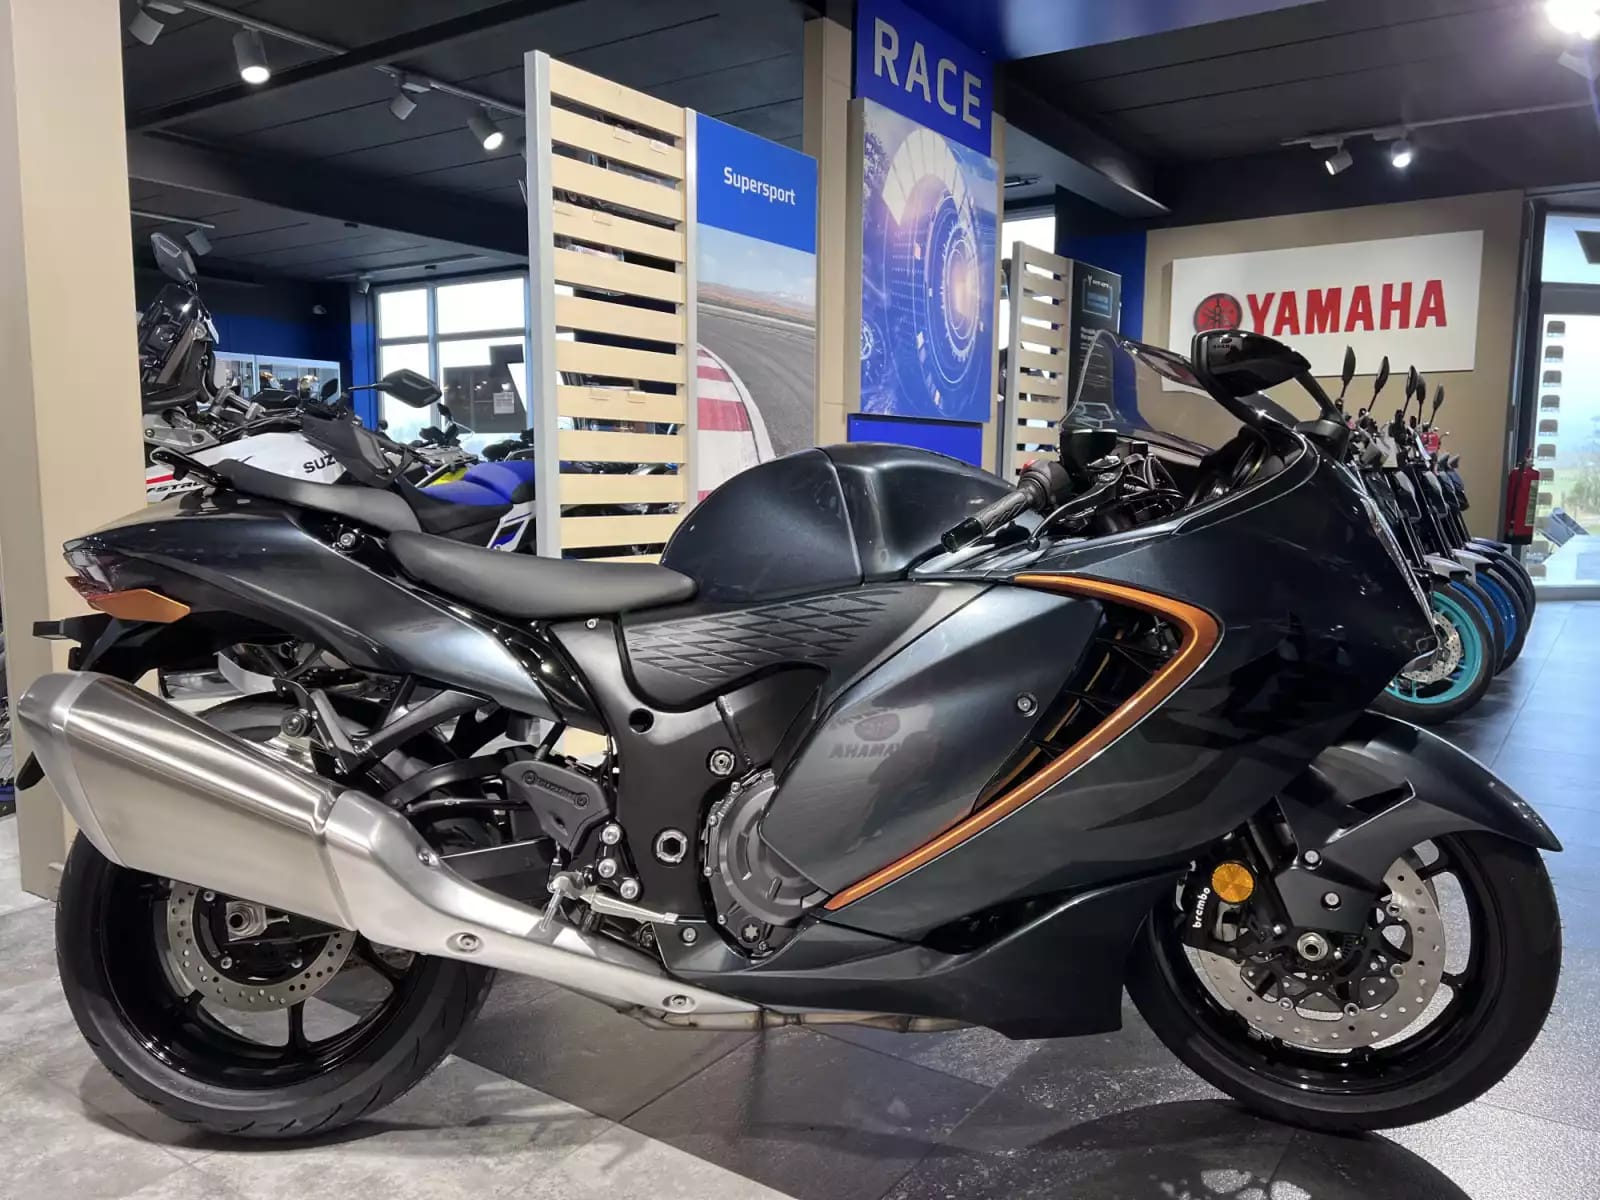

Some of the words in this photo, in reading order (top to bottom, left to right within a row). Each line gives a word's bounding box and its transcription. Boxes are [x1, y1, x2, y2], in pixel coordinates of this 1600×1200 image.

[874, 16, 982, 130] RACE
[723, 166, 796, 205] Supersport
[1246, 279, 1448, 336] YAMAHA
[303, 454, 337, 473] SUZ
[1192, 887, 1211, 928] brembo
